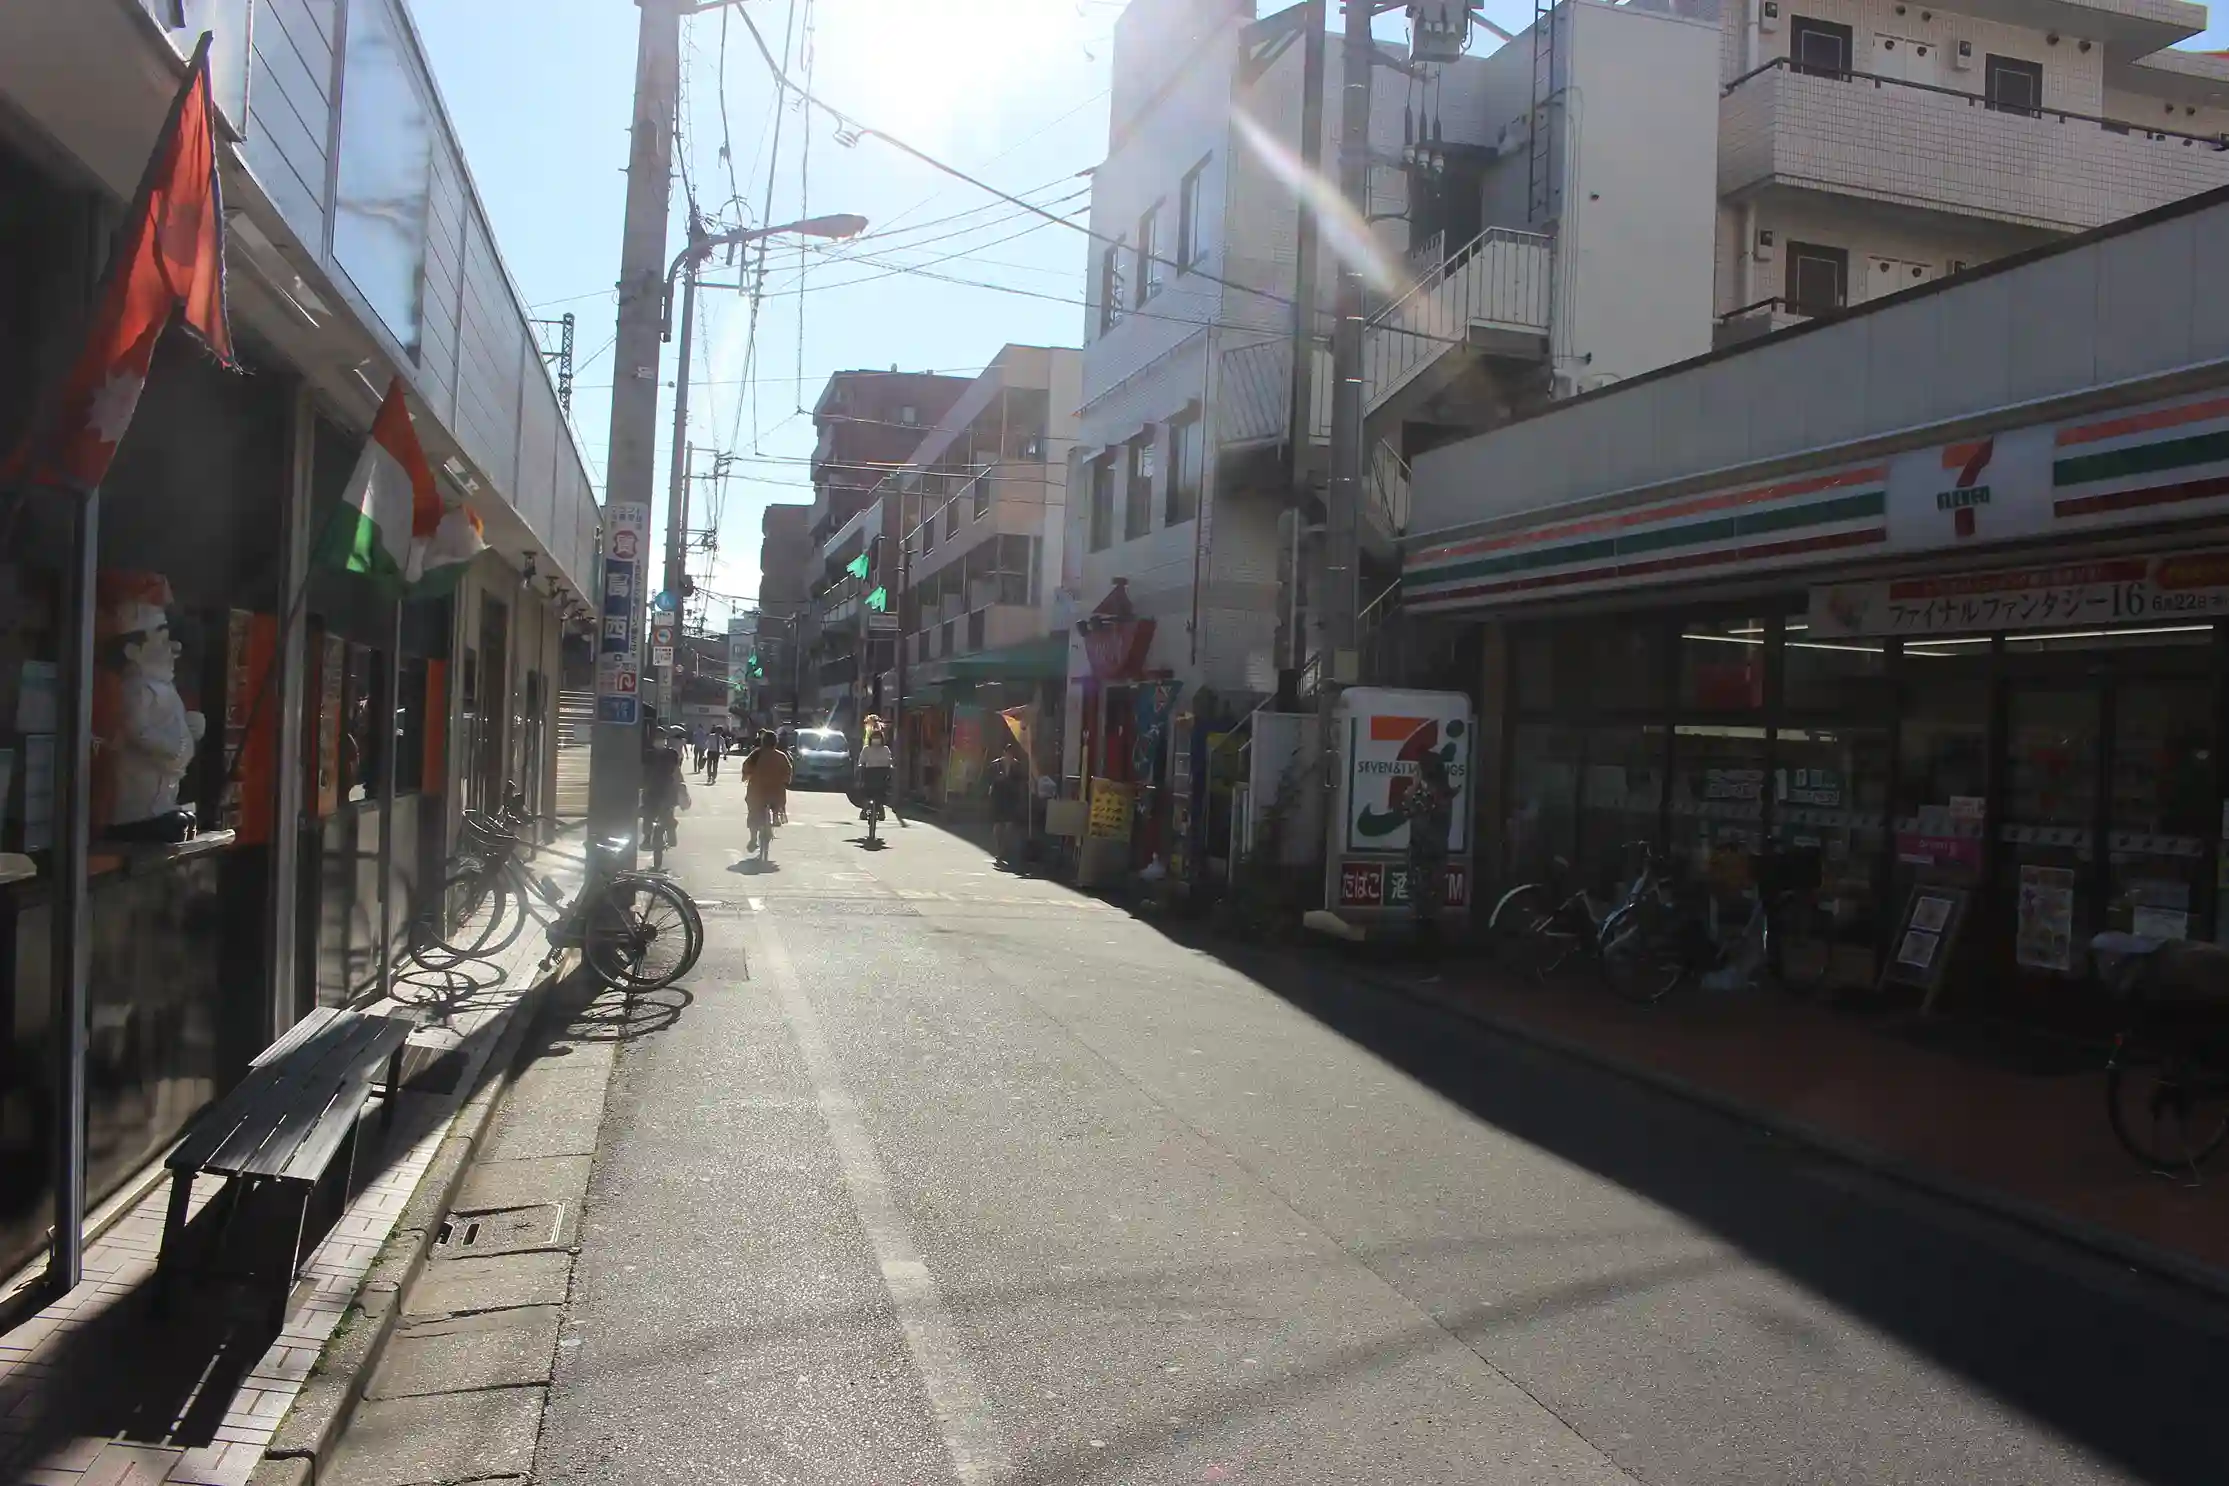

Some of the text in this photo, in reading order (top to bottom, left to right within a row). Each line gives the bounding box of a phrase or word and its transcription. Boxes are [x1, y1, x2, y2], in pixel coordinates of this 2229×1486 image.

[1888, 581, 2144, 627] ファイナルファンタジー16
[1343, 871, 1380, 899] たばこ
